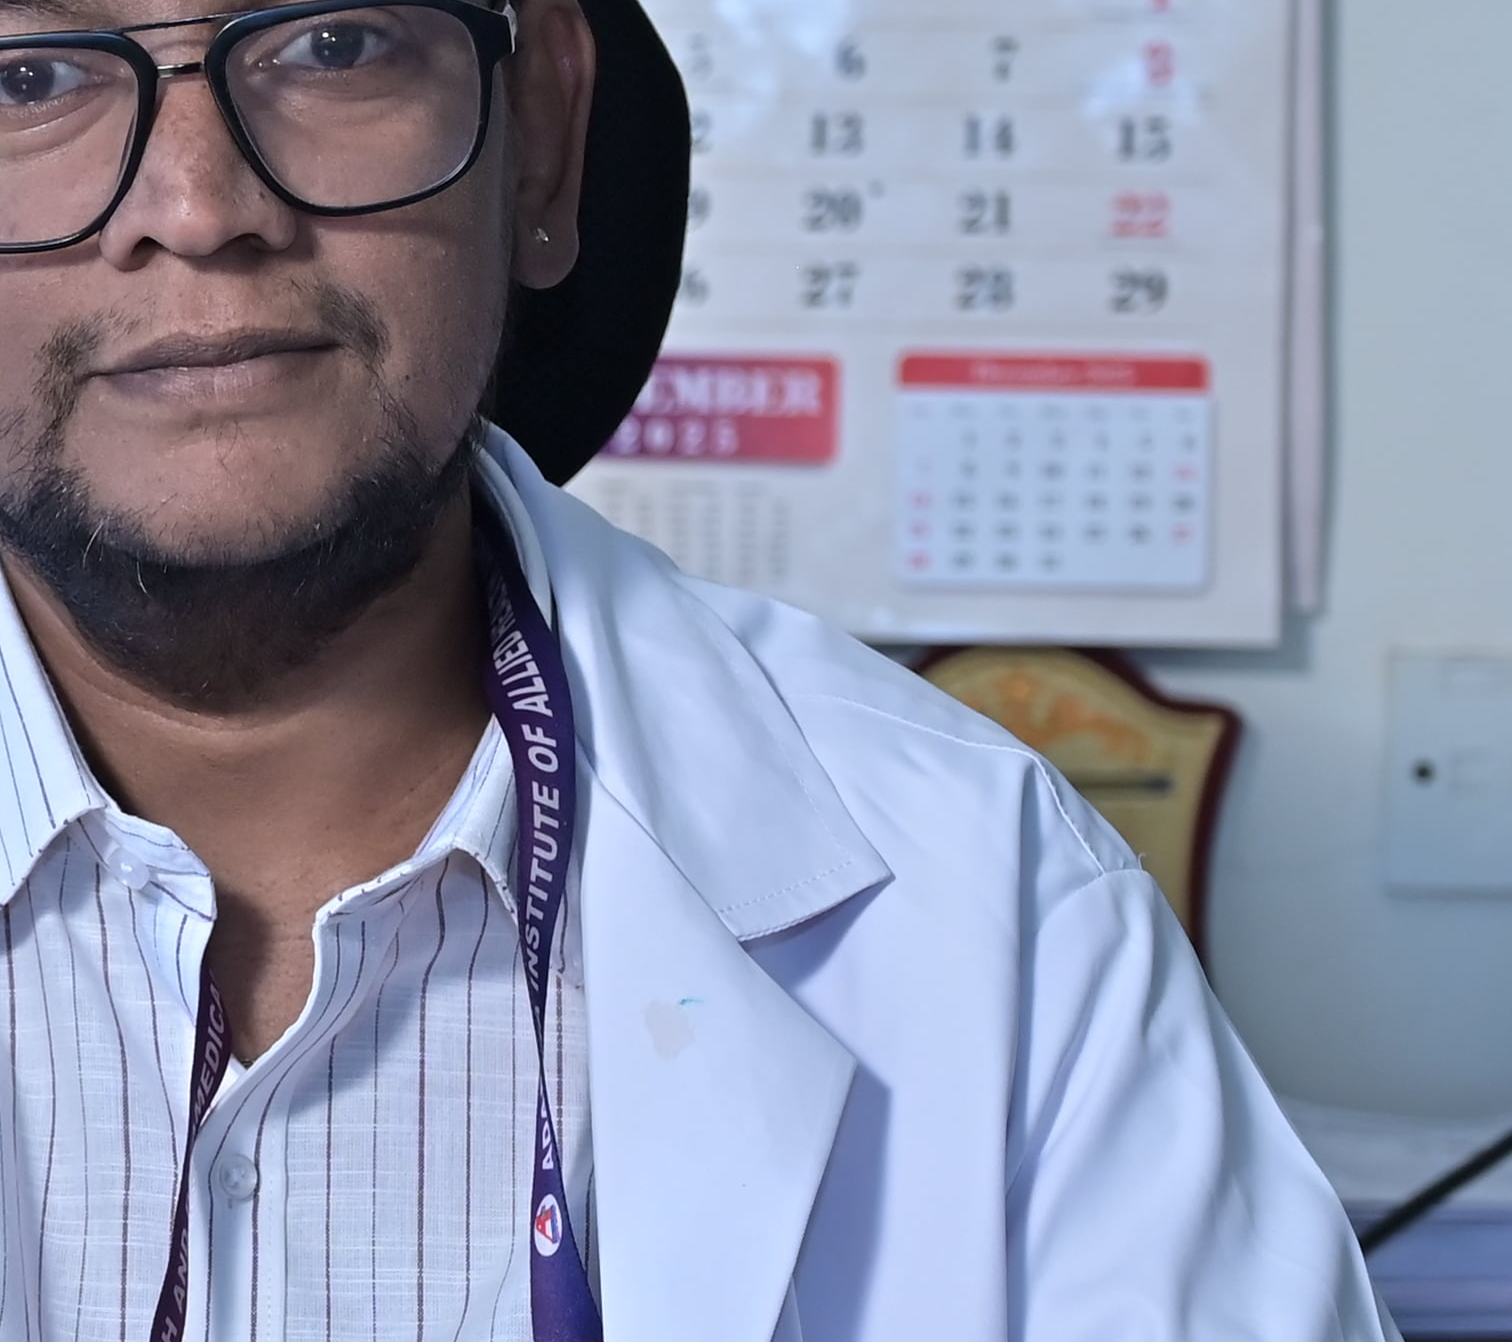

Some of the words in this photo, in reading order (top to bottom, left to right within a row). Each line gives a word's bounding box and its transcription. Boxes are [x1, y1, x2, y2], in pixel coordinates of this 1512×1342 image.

[835, 39, 866, 82] 6
[992, 35, 1019, 82] 7
[810, 112, 864, 157] 13
[964, 114, 1014, 158] 14
[1118, 115, 1172, 161] 15
[802, 188, 864, 234] 20
[959, 189, 1012, 235] 21
[1110, 190, 1171, 239] 22
[799, 261, 859, 309] 27
[956, 265, 1015, 311] 28
[1110, 267, 1169, 314] 29
[633, 365, 823, 418] EMBER
[492, 629, 554, 719] ALLIED
[520, 723, 560, 774] OF
[525, 781, 561, 991] INSTITUTE
